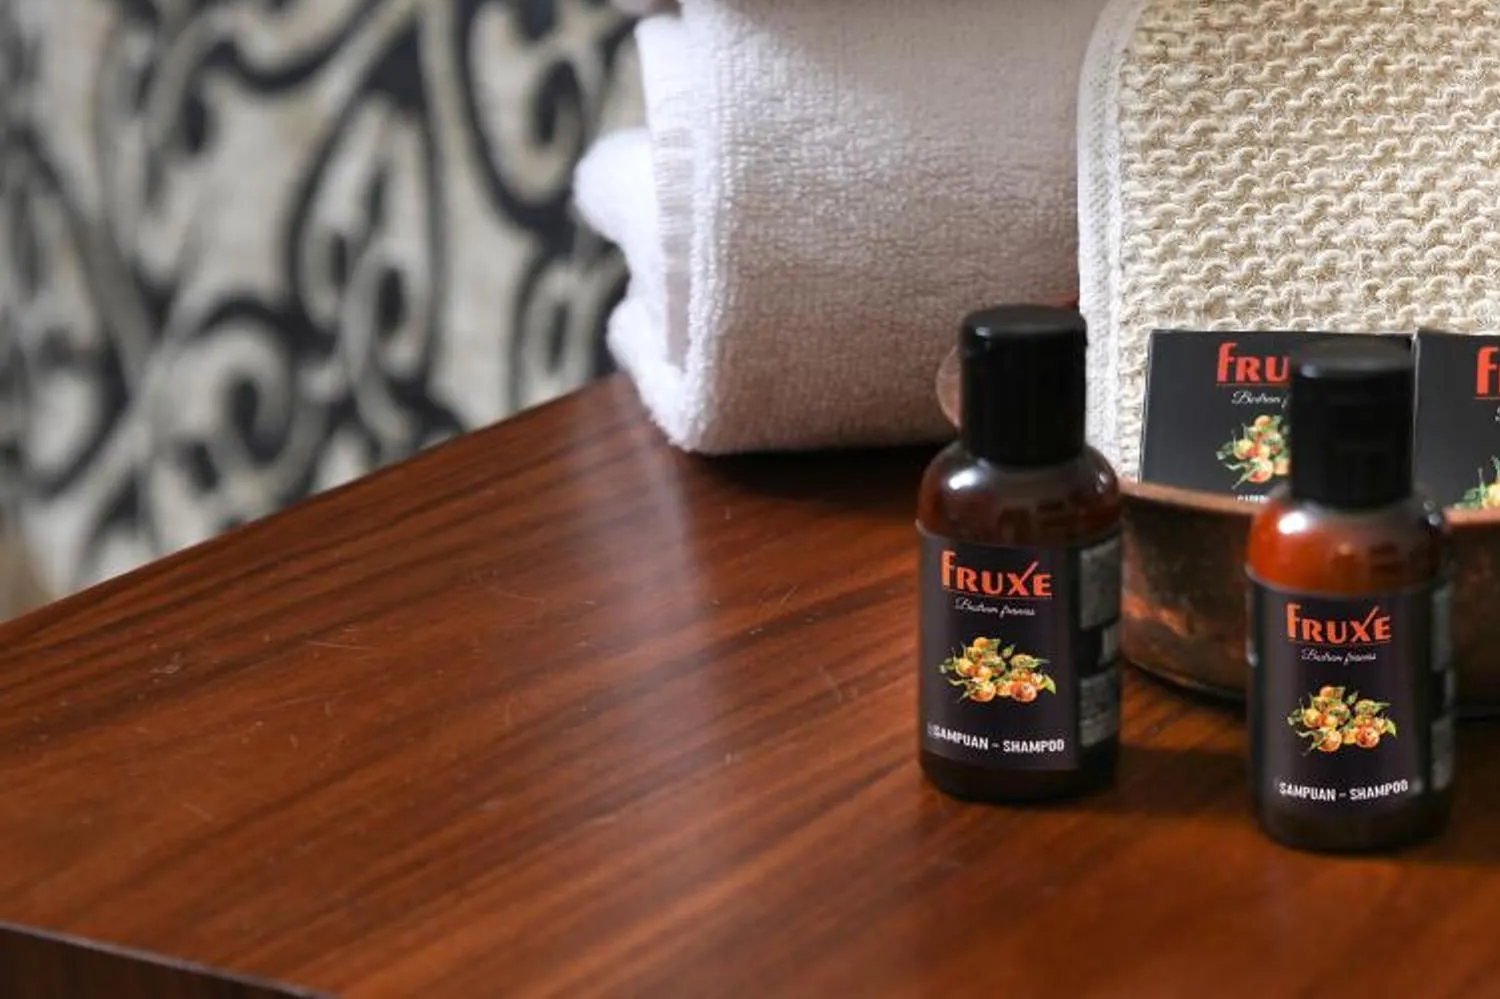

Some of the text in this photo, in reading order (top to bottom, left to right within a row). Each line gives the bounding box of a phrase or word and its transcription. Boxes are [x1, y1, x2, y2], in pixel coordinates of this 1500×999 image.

[1216, 342, 1290, 384] FRU
[941, 550, 1053, 597] FRUXE
[1286, 603, 1392, 644] FRUXE
[1003, 738, 1065, 753] SHAMPOO
[1349, 778, 1409, 800] SHAMPOO
